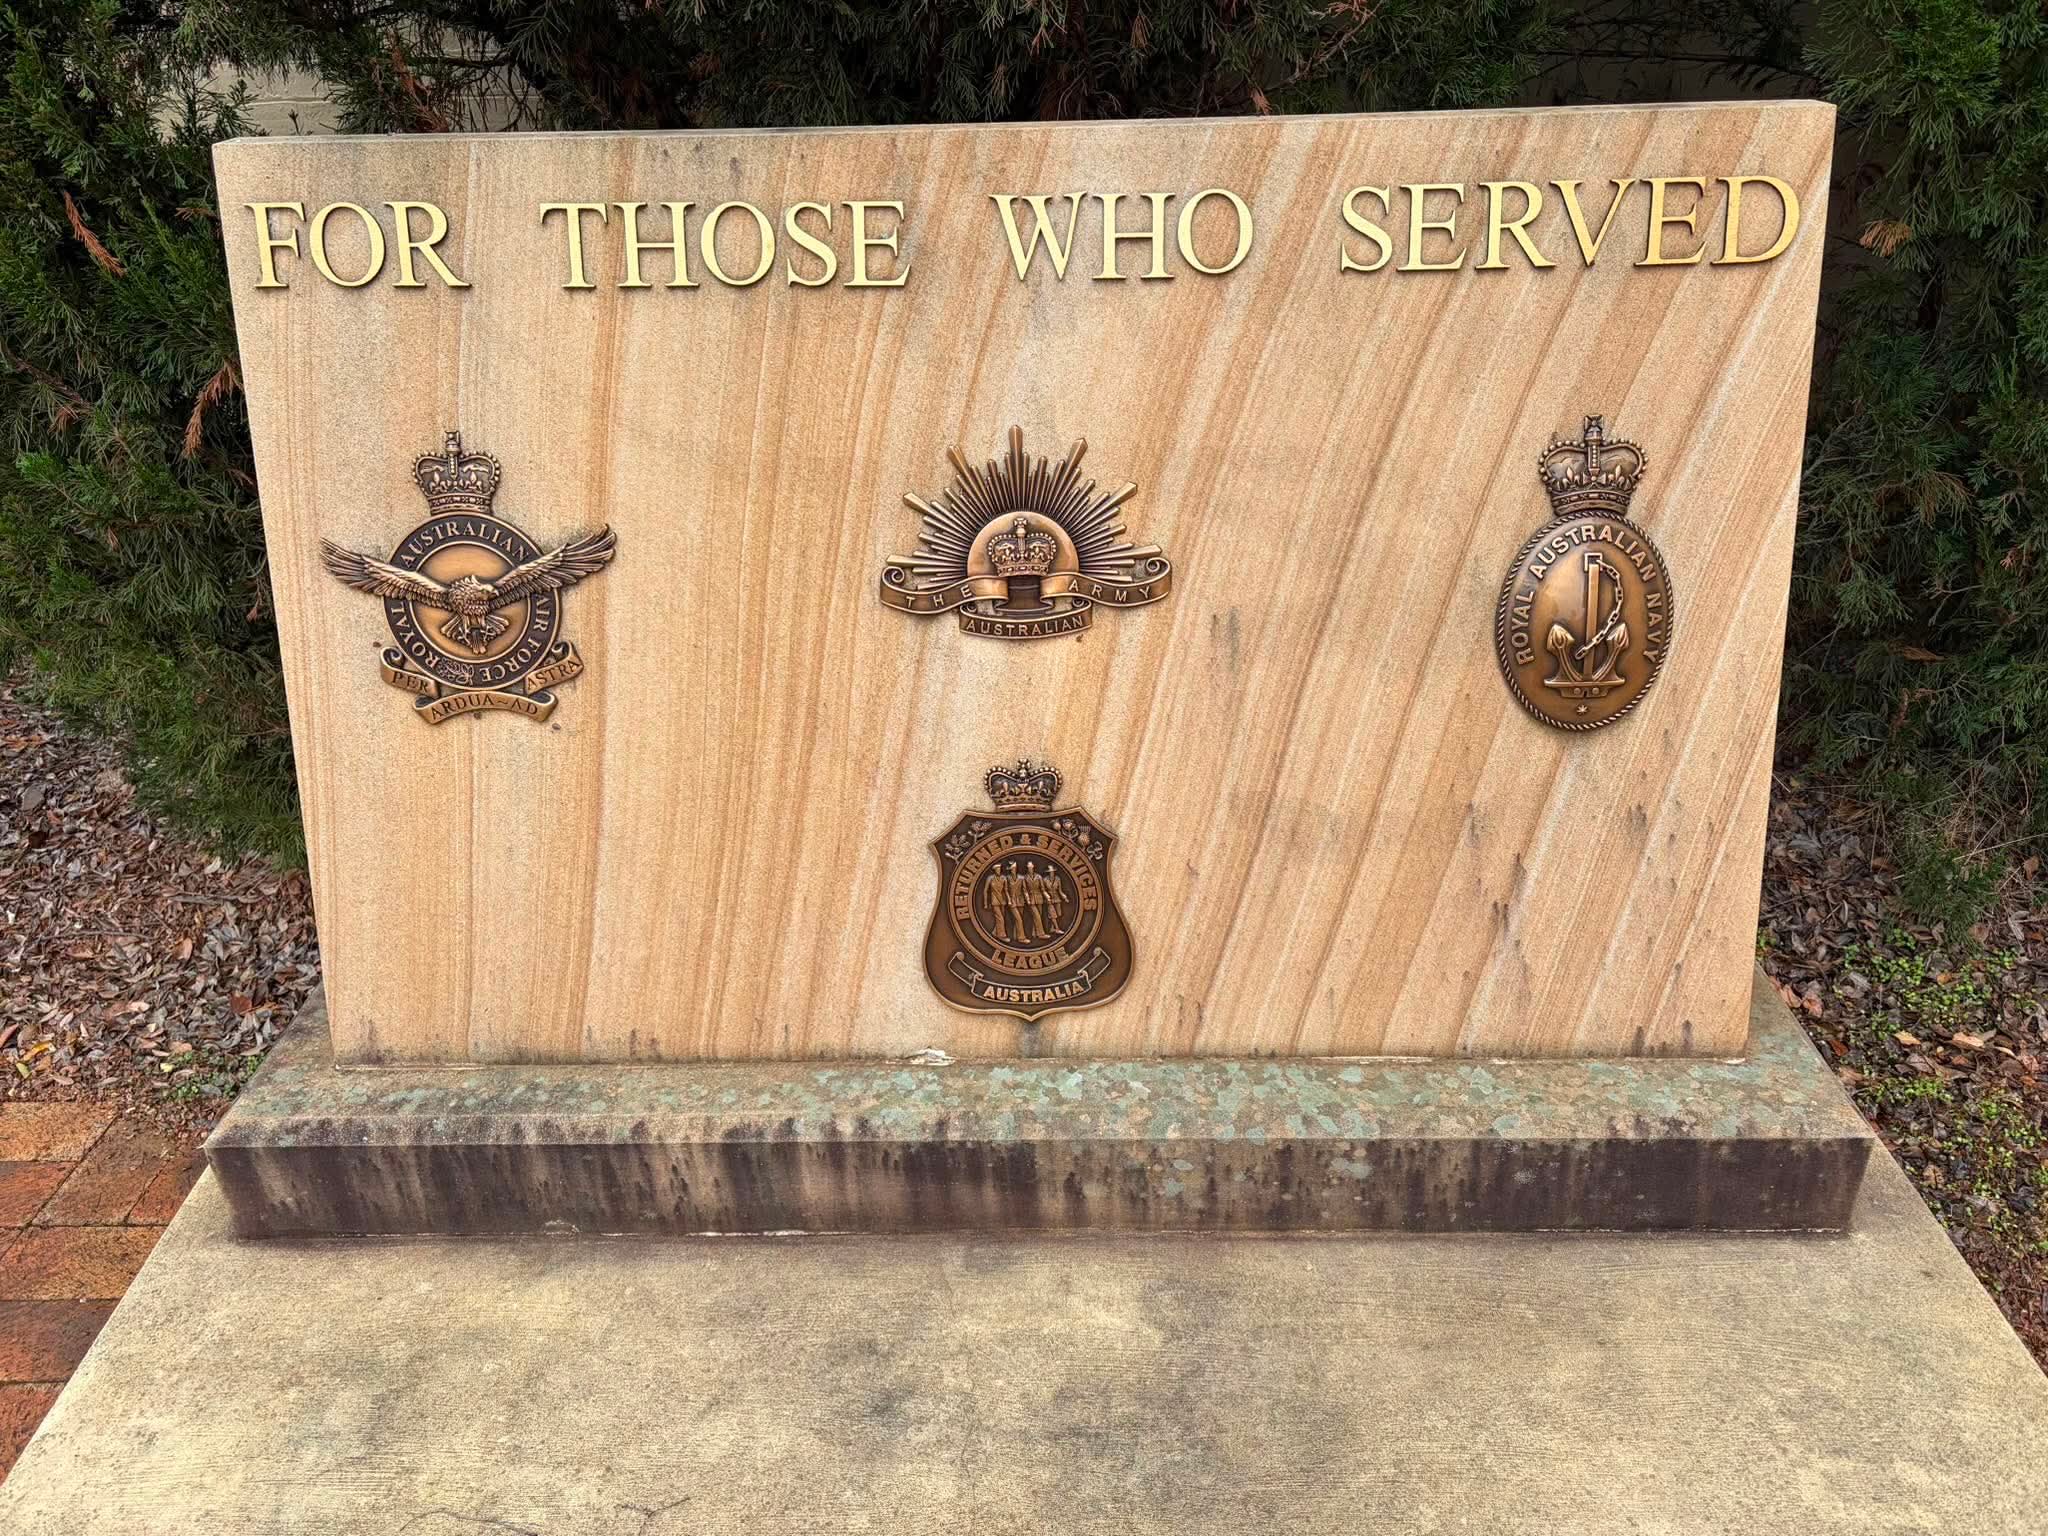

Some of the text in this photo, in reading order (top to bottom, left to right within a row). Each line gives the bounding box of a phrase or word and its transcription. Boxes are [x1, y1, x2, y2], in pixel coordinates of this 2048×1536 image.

[243, 175, 1800, 289] FOR THOSE WHO SERVED
[391, 521, 551, 682] ROYAL AUSTRALIAN AIR FORCE
[905, 580, 1152, 636] THE AUSTRALIAN ARMY
[1510, 525, 1662, 665] ROYAL AUSTRALIAN NAVY
[392, 672, 430, 693] PER
[431, 695, 495, 720] ARDUA
[527, 660, 581, 691] ASTRA
[953, 834, 1098, 921] RETURNED & SERVICES
[983, 981, 1084, 1002] AUSTRALIA
[992, 947, 1069, 970] LEAGUE
